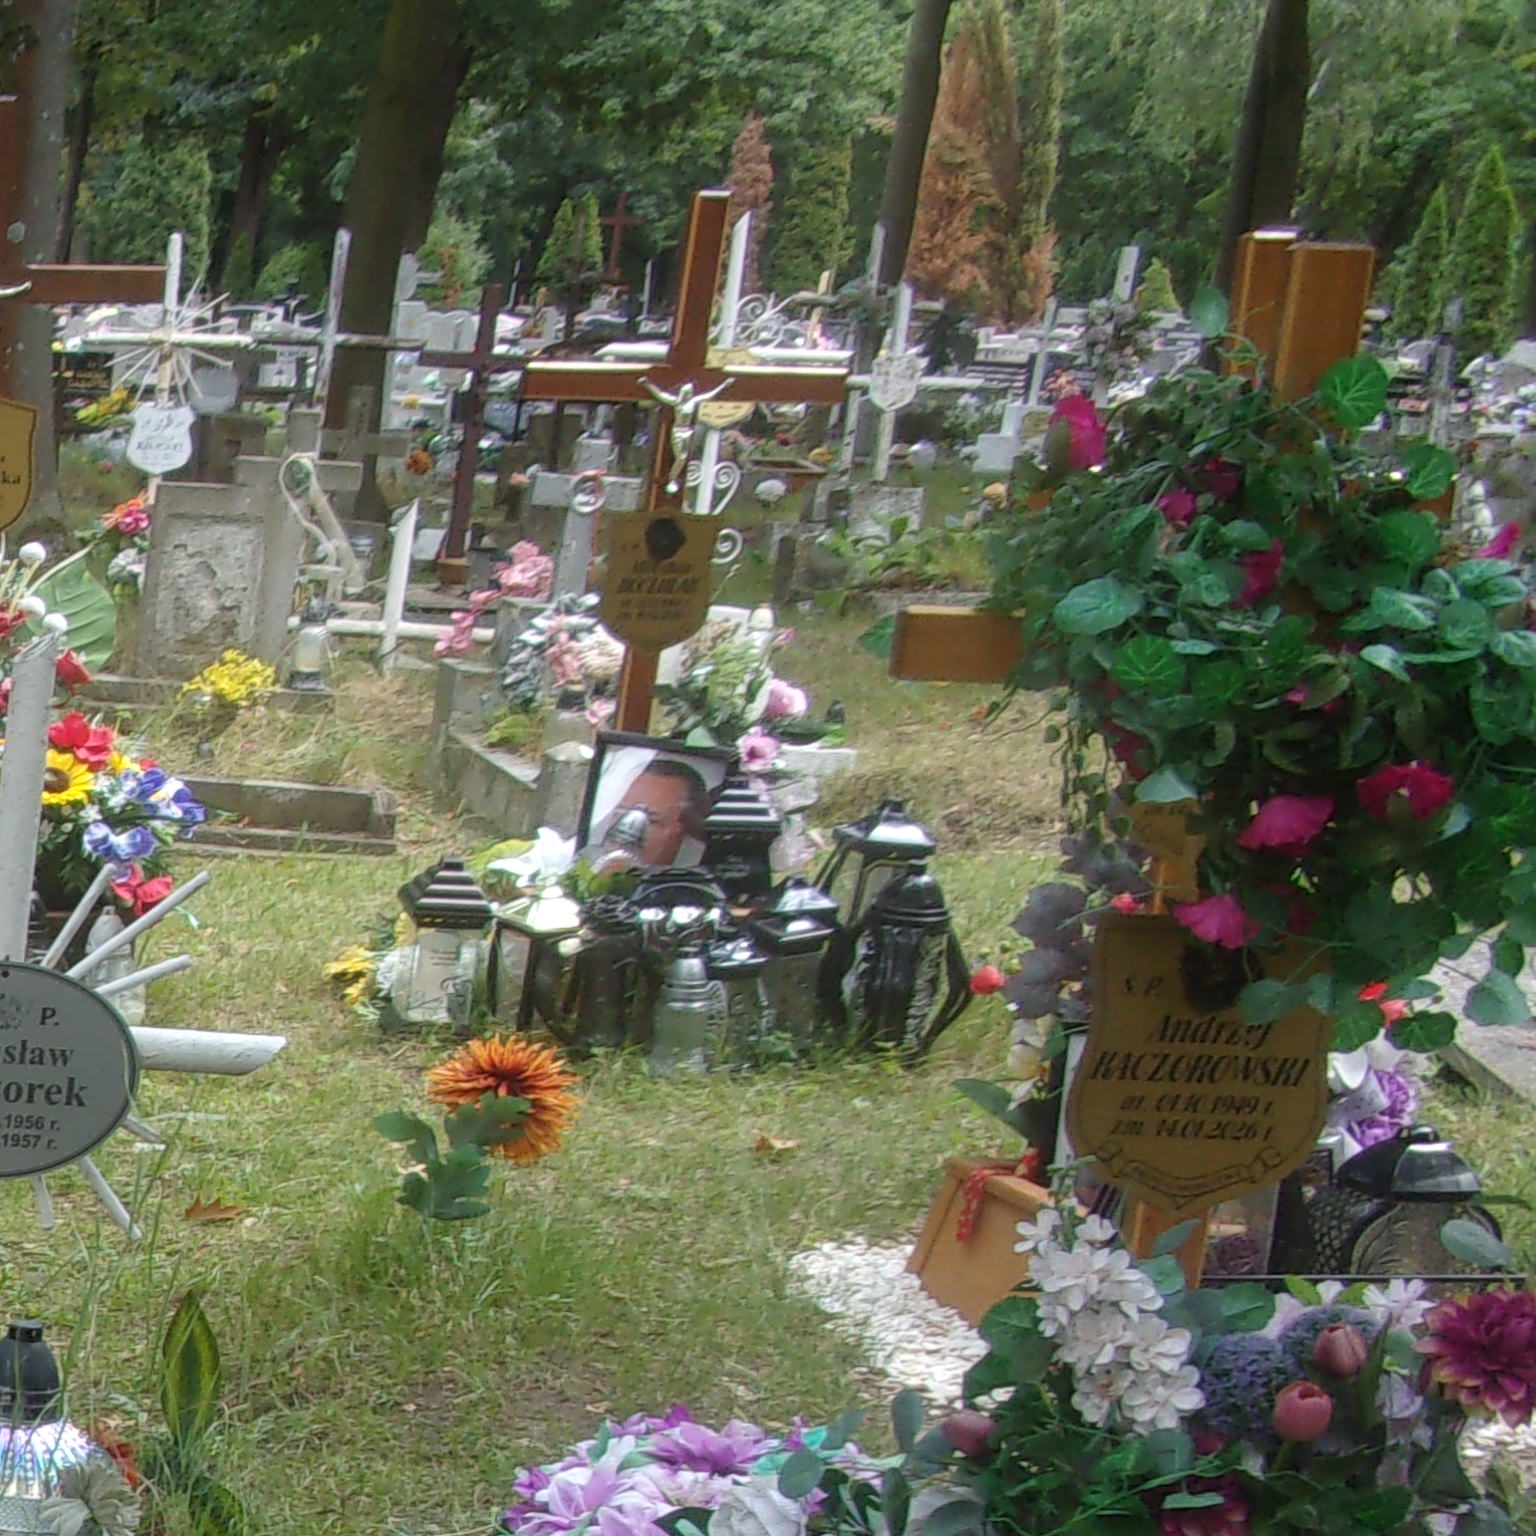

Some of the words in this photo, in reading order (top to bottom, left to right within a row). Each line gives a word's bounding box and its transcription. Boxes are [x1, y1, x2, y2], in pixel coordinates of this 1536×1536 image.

[39, 1007, 60, 1027] P.
[1148, 1014, 1273, 1050] Andrzej
[49, 1119, 61, 1132] r.
